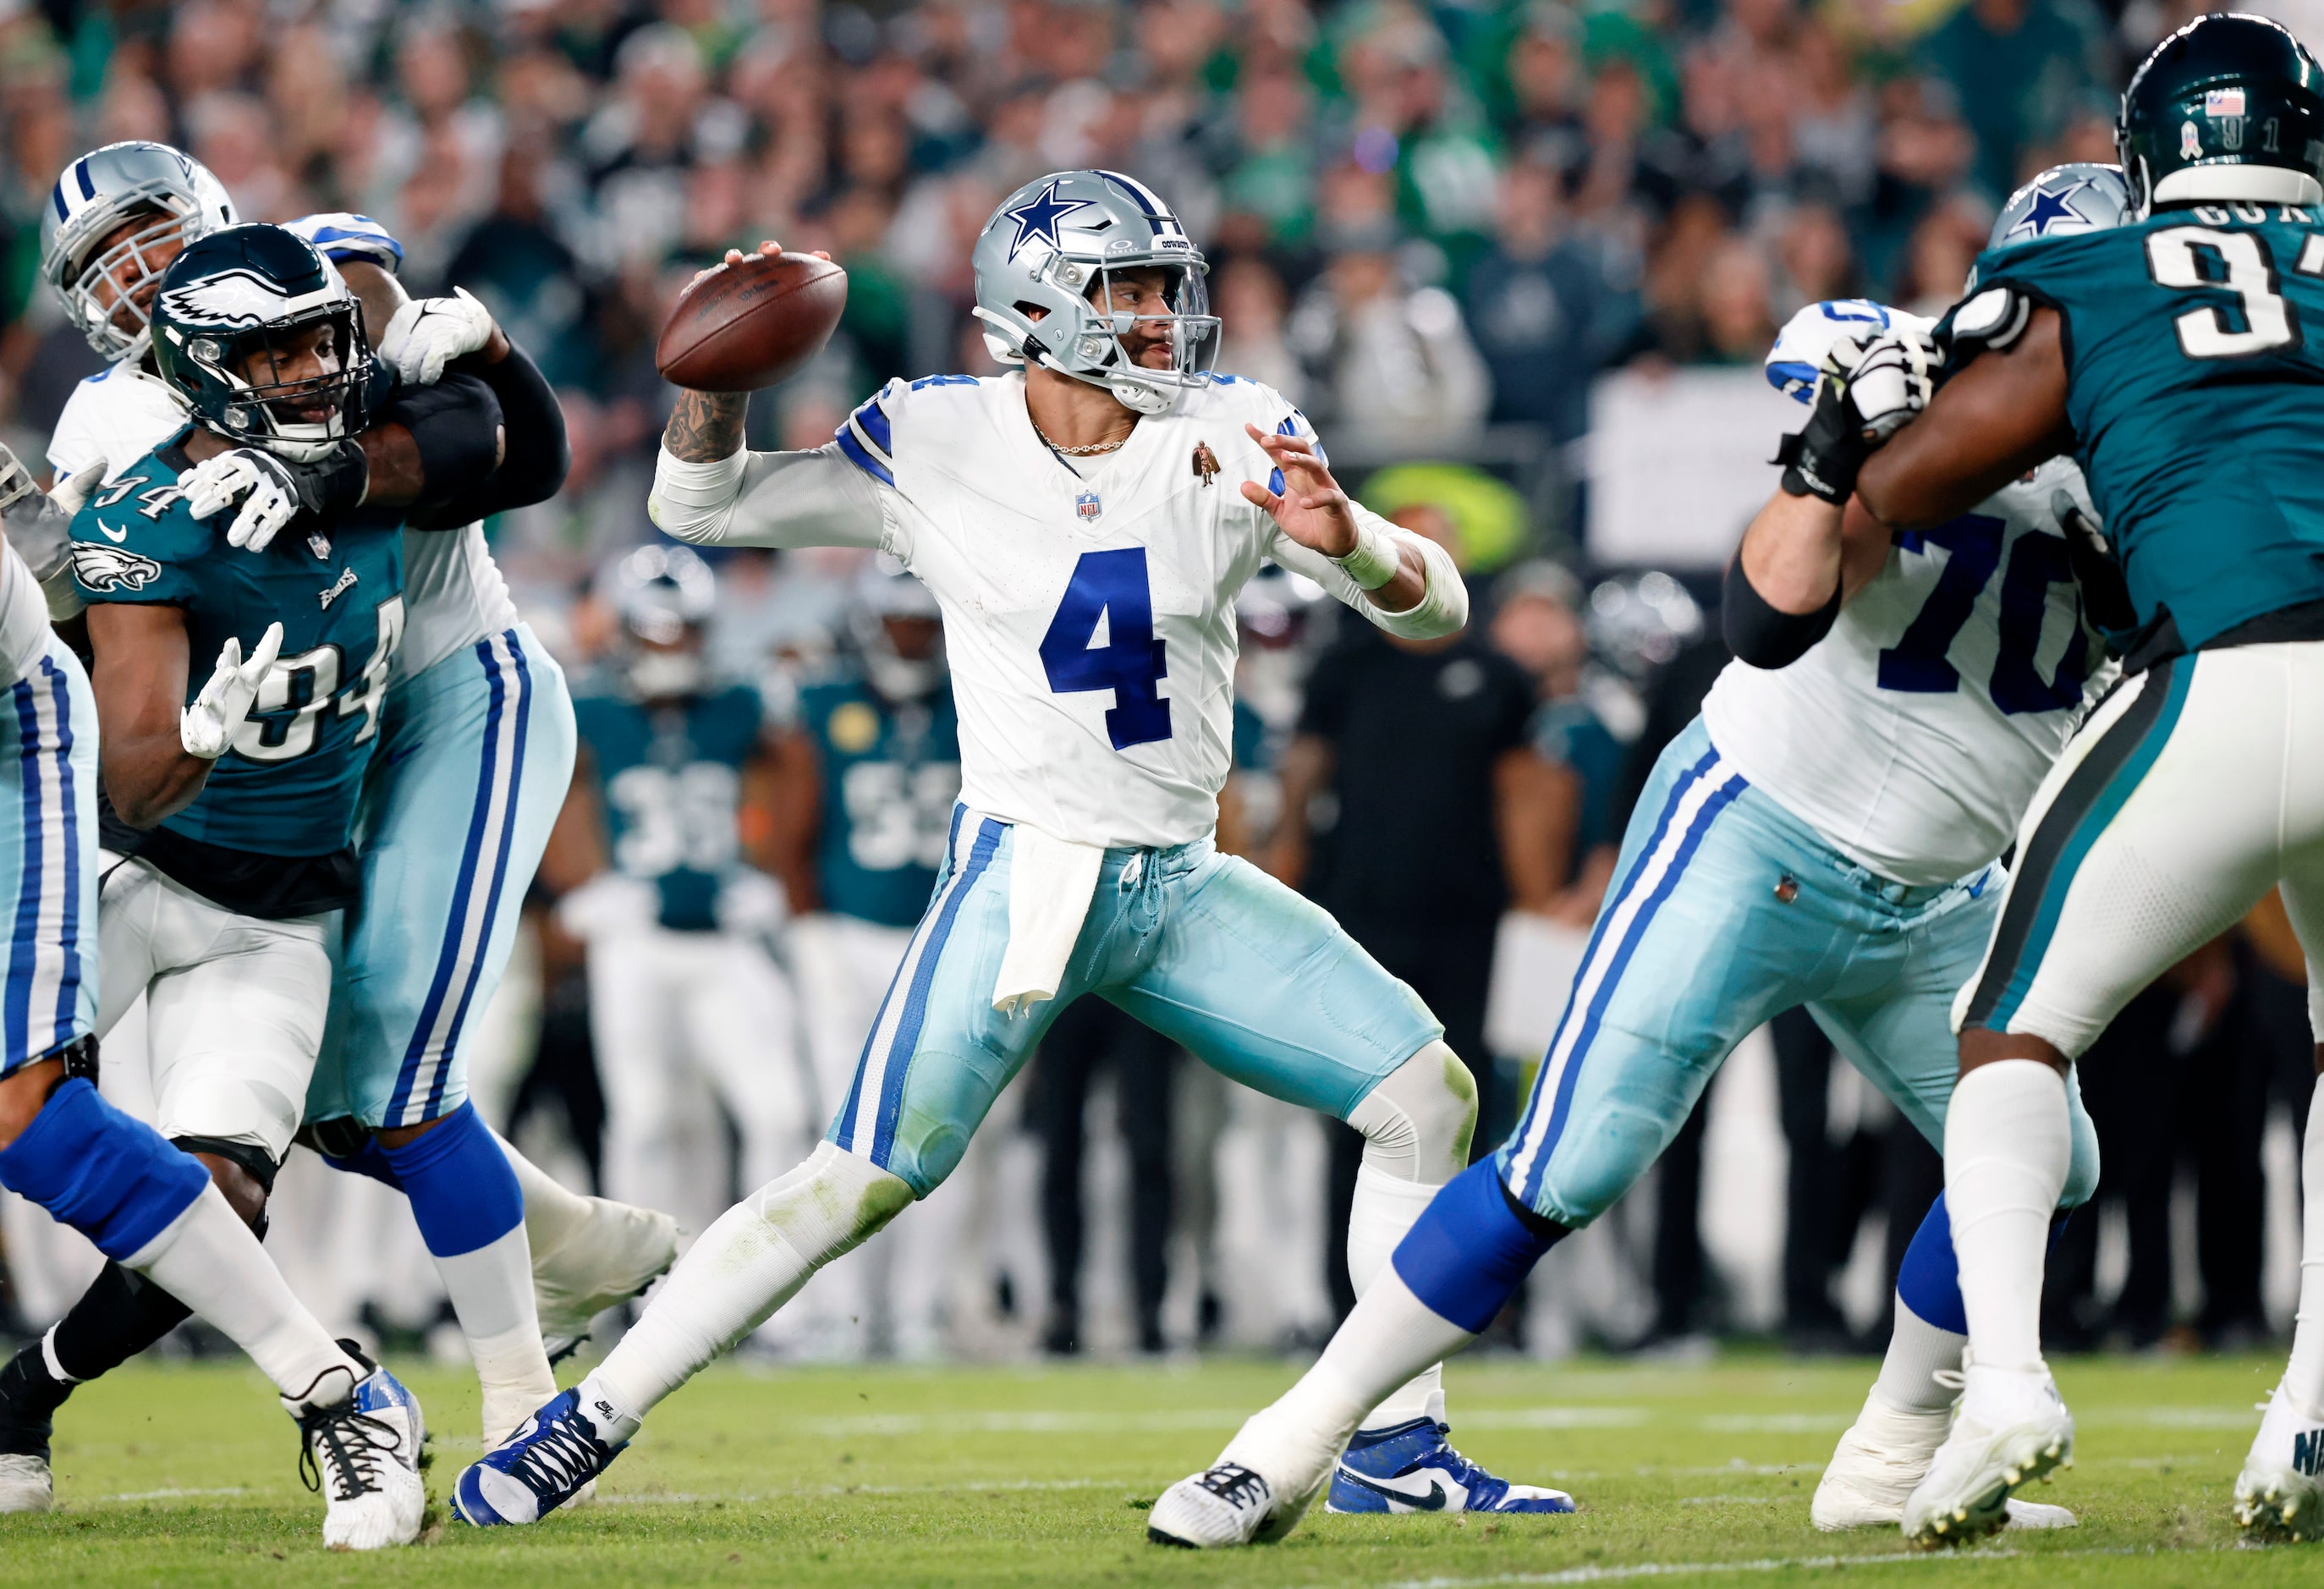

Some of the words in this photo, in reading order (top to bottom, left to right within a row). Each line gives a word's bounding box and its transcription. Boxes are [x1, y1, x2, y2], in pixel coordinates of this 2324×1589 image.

[2143, 224, 2324, 359] 9
[228, 591, 408, 762] 94
[1038, 546, 1173, 751] 4
[1877, 512, 2089, 717] 70
